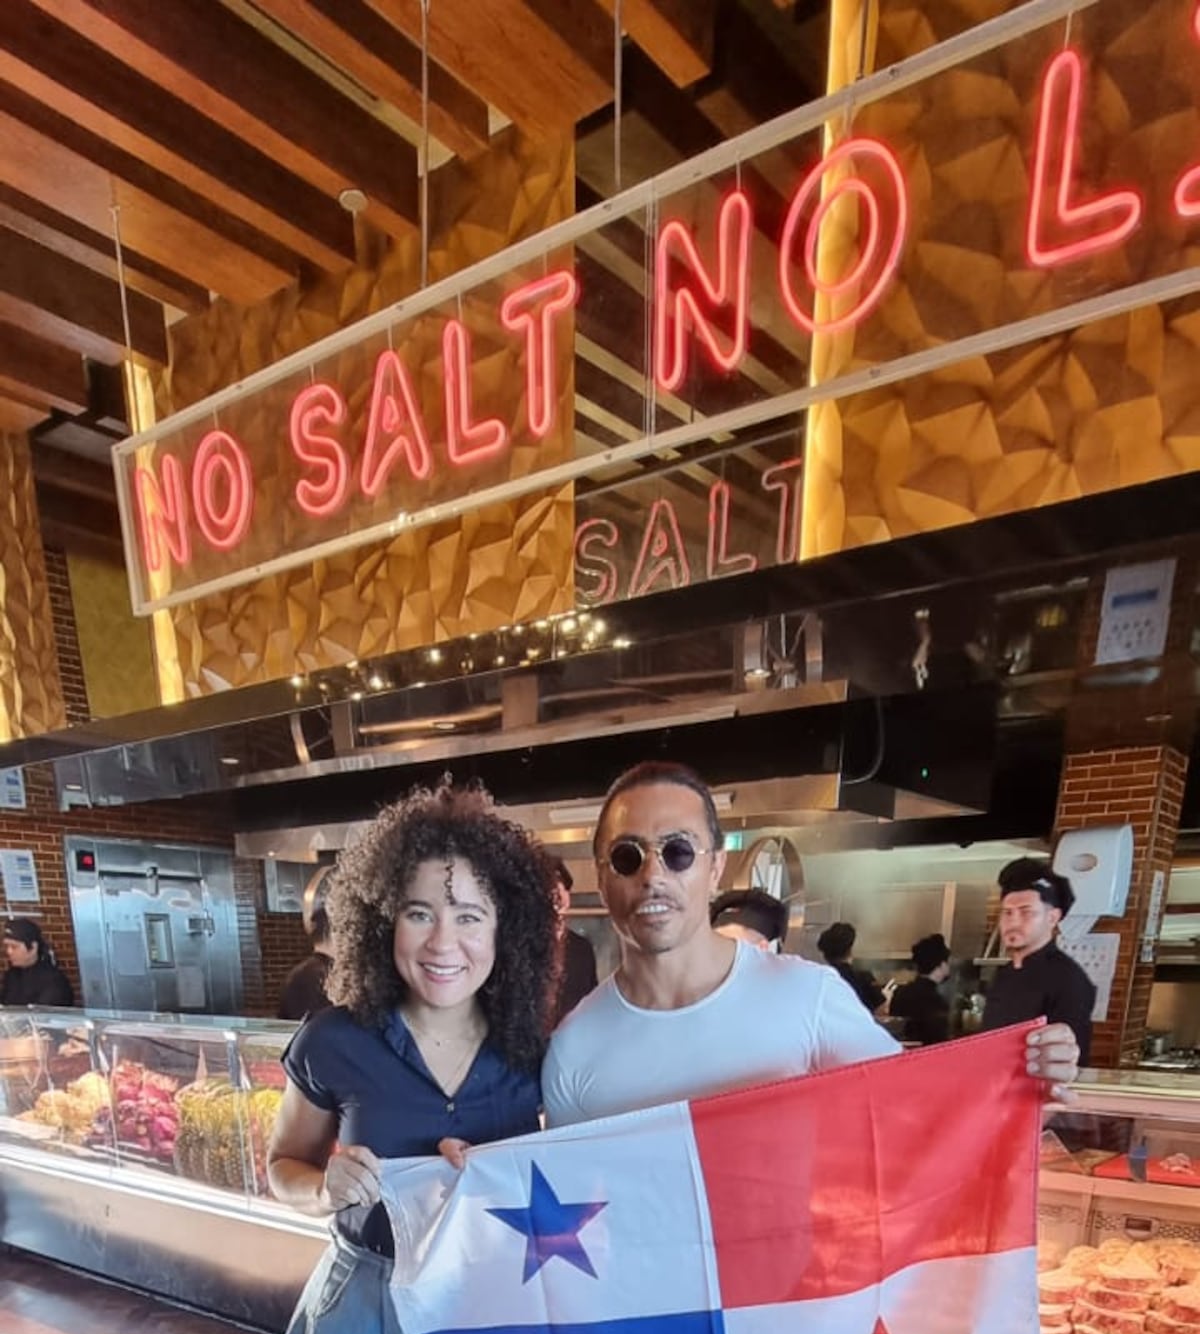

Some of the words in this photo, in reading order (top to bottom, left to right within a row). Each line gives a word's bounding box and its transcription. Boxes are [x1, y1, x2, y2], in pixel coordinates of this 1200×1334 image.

[135, 430, 253, 571] NO
[290, 270, 577, 516] SALT
[656, 138, 906, 390] NO
[1027, 0, 1200, 265] L
[575, 457, 801, 602] SALT
